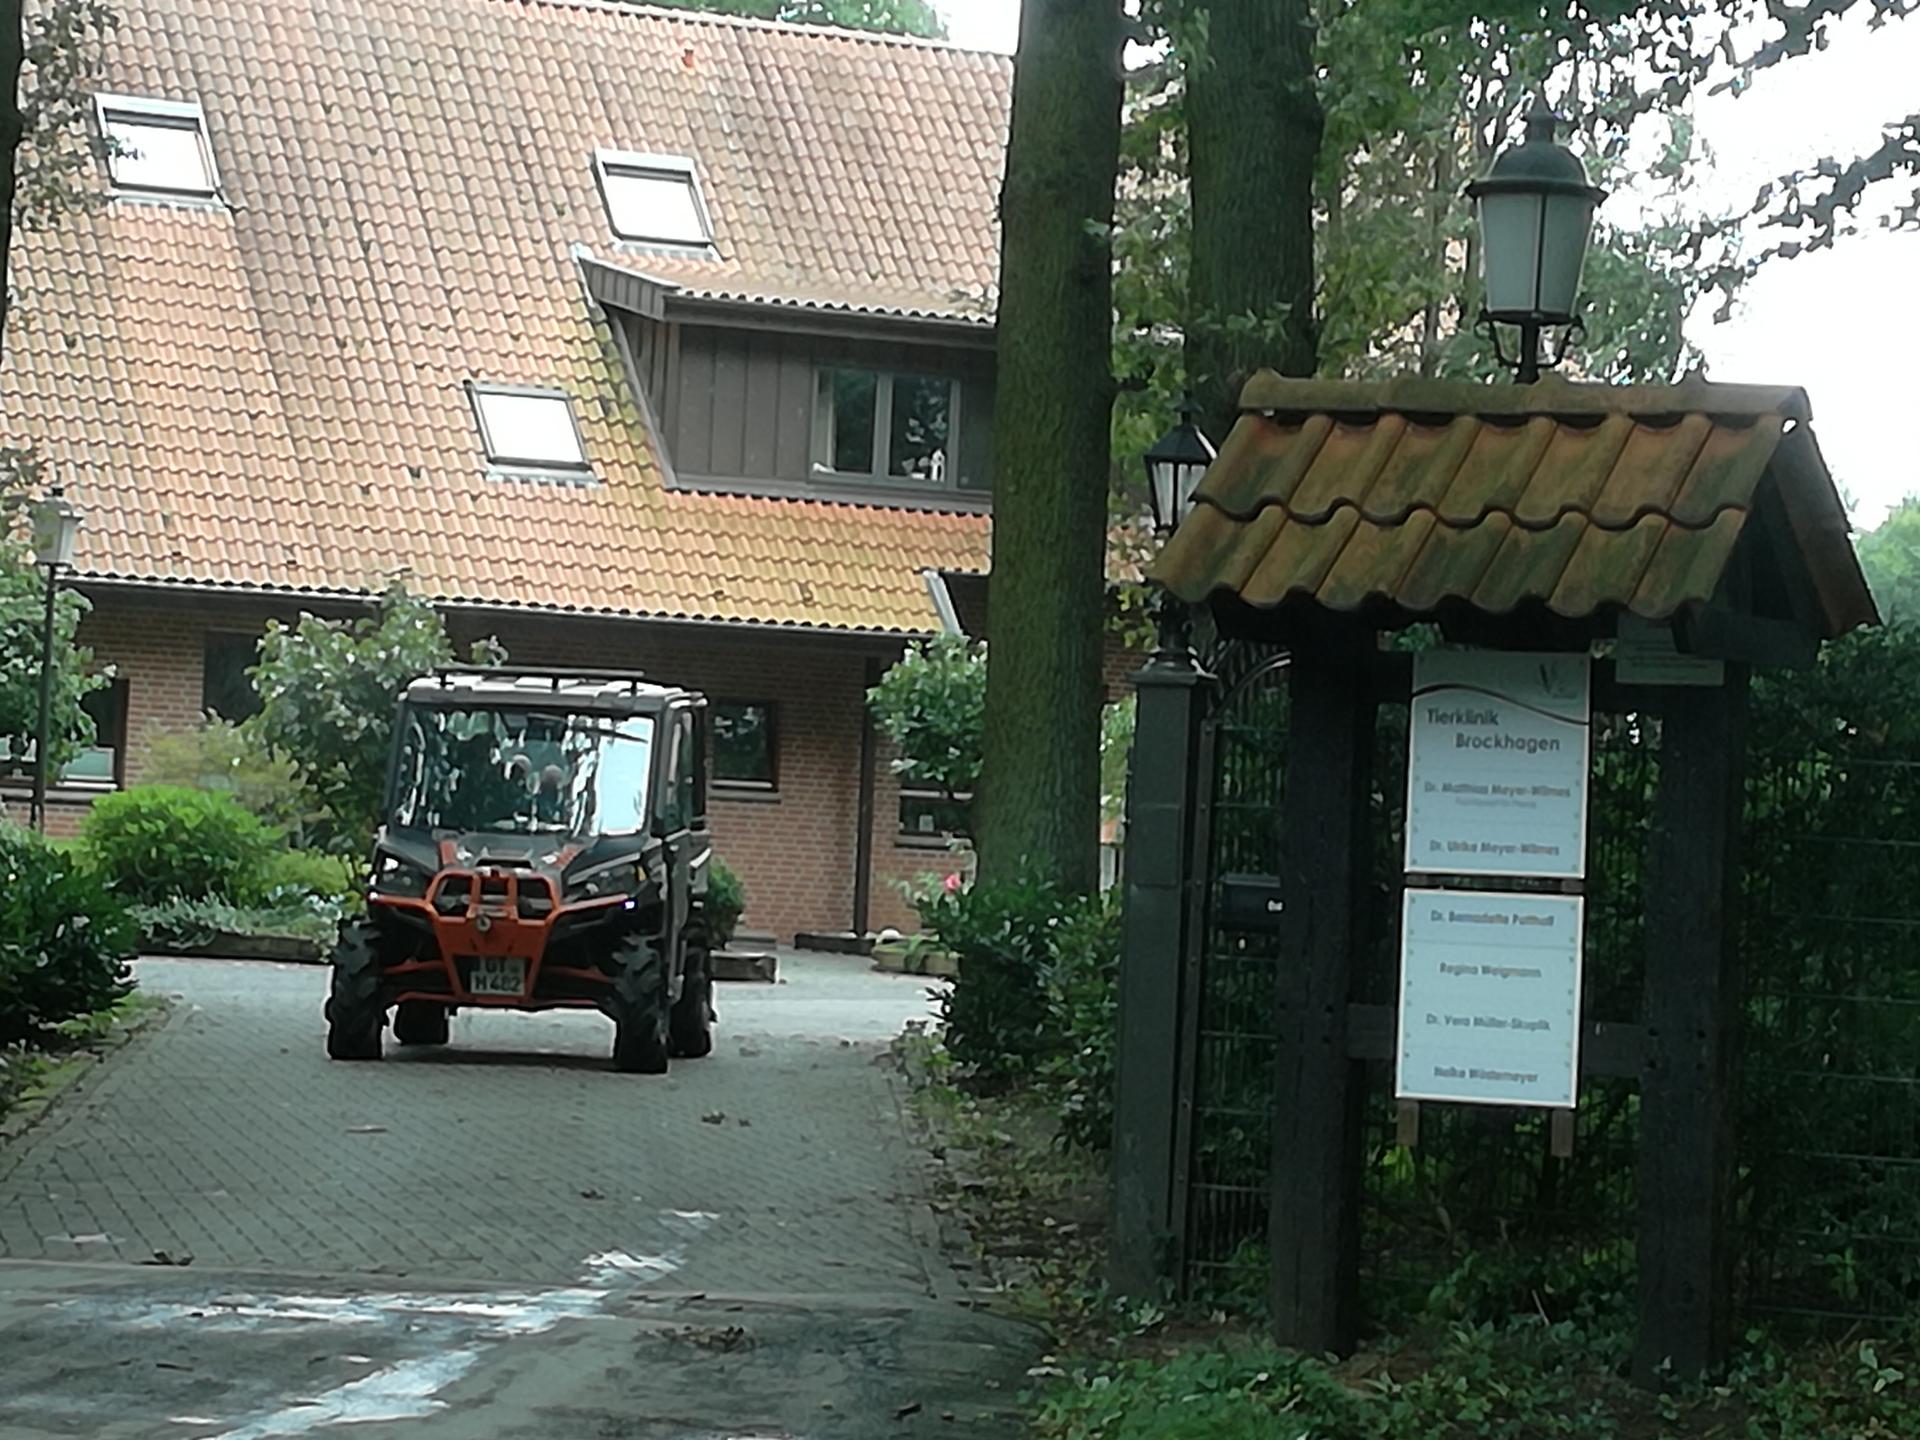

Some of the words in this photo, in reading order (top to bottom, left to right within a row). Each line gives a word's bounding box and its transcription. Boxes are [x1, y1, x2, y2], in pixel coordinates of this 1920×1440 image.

[1427, 708, 1499, 726] Tierklinik
[1455, 732, 1560, 753] Brockhagen
[1424, 781, 1438, 793] Dr.
[1429, 840, 1444, 852] Dr.
[1430, 910, 1445, 922] Dr.
[1426, 1013, 1440, 1025] Dr.
